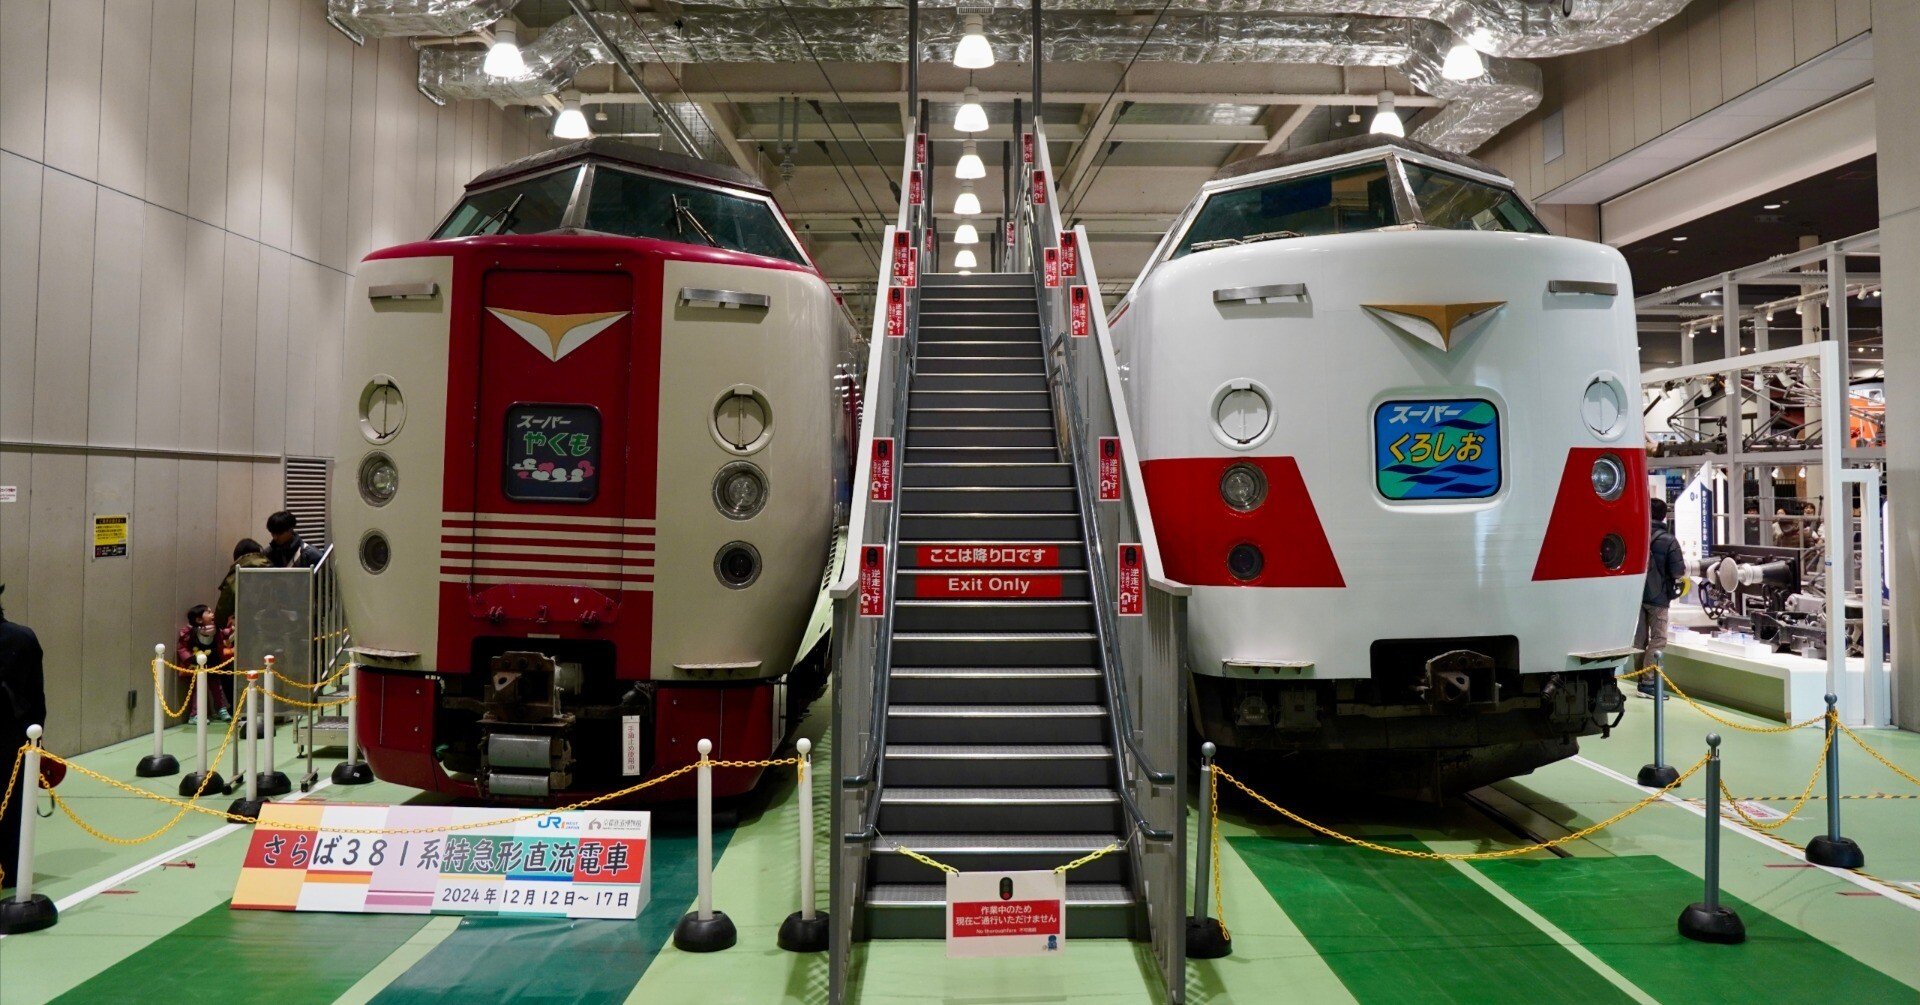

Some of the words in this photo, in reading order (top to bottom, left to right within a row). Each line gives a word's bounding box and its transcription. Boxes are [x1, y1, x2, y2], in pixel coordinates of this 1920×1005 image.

[516, 415, 572, 429] スーパー
[1389, 405, 1462, 424] スーパー
[523, 431, 592, 456] やくも
[1389, 432, 1486, 463] くろしお
[930, 548, 1046, 563] ここは降り口です
[948, 577, 983, 591] Exit
[988, 577, 1030, 594] Only
[538, 816, 562, 829] JR
[263, 833, 629, 876] さらば381系特急形直流電車
[980, 904, 1032, 916] 作業中のため
[955, 913, 1057, 926] 現在ご通行いただけません
